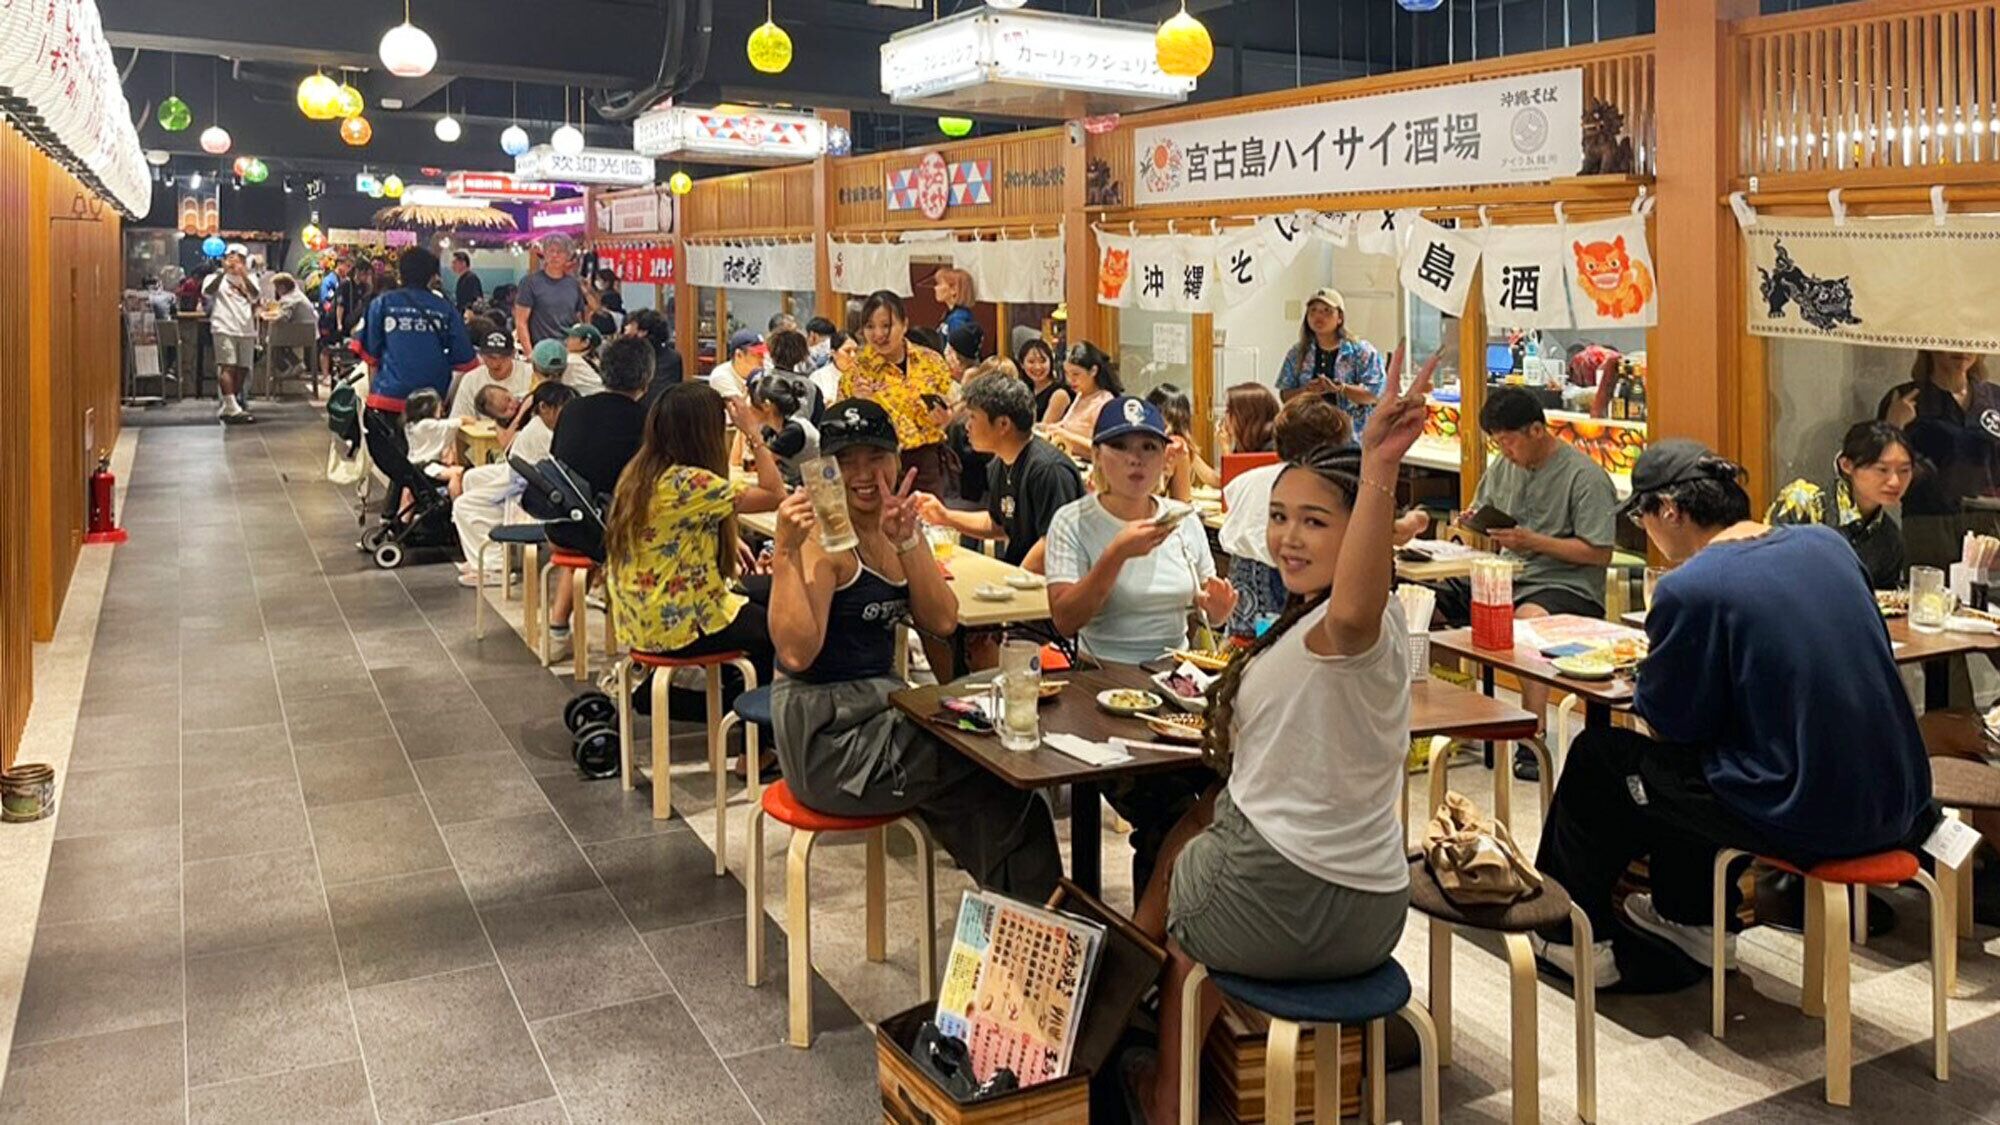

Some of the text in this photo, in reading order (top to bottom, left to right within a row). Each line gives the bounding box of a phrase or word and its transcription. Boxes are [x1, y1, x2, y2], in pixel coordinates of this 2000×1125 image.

[1500, 86, 1558, 107] 沖縄そば
[1186, 112, 1481, 183] 宮古島ハイサイ酒場
[552, 155, 643, 175] 欢迎光临
